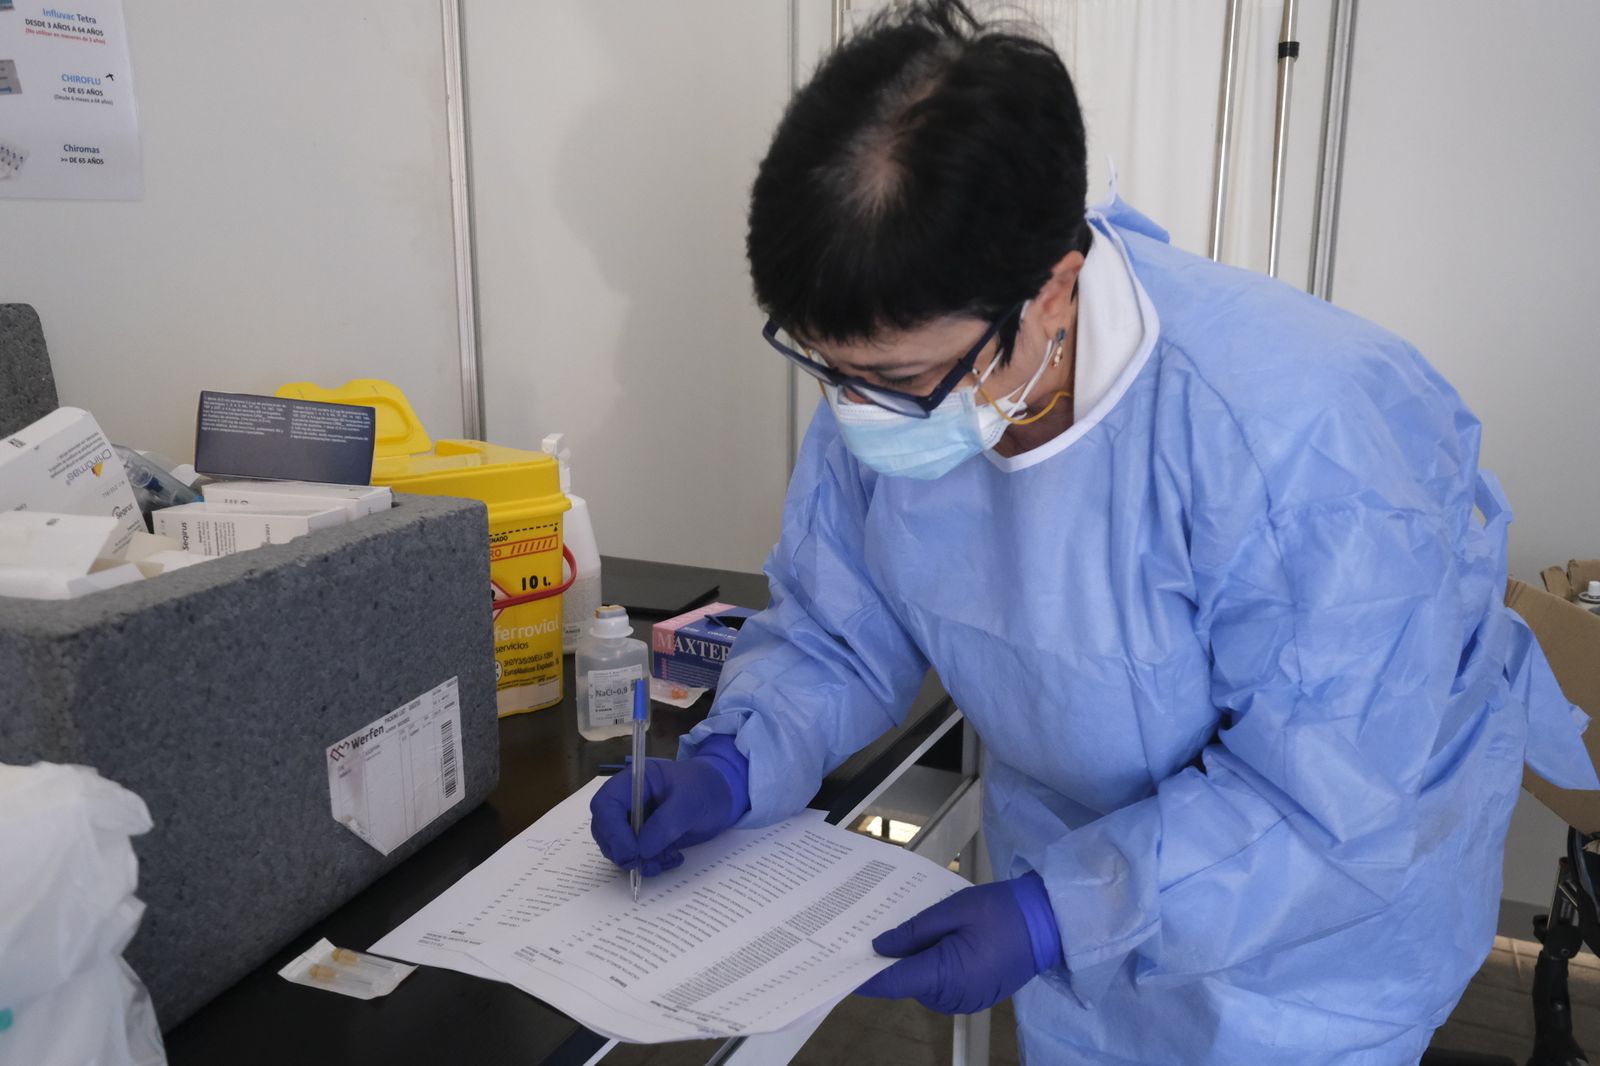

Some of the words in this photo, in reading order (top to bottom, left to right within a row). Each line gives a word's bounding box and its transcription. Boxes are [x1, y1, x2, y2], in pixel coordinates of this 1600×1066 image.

[42, 8, 75, 21] Influvac
[76, 13, 97, 24] Tetra
[25, 18, 46, 28] DESDE
[52, 22, 71, 32] AÑOS
[86, 27, 104, 37] AÑOS
[61, 73, 101, 85] CHIROFLU
[77, 87, 85, 95] 65
[86, 88, 104, 97] AÑOS
[63, 144, 100, 154] Chiromas
[87, 156, 104, 165] AÑOS
[181, 522, 190, 551] Seqirus
[522, 575, 539, 591] 10
[494, 613, 560, 641] ferrovial
[495, 642, 529, 653] servicios
[351, 725, 385, 750] Werfen
